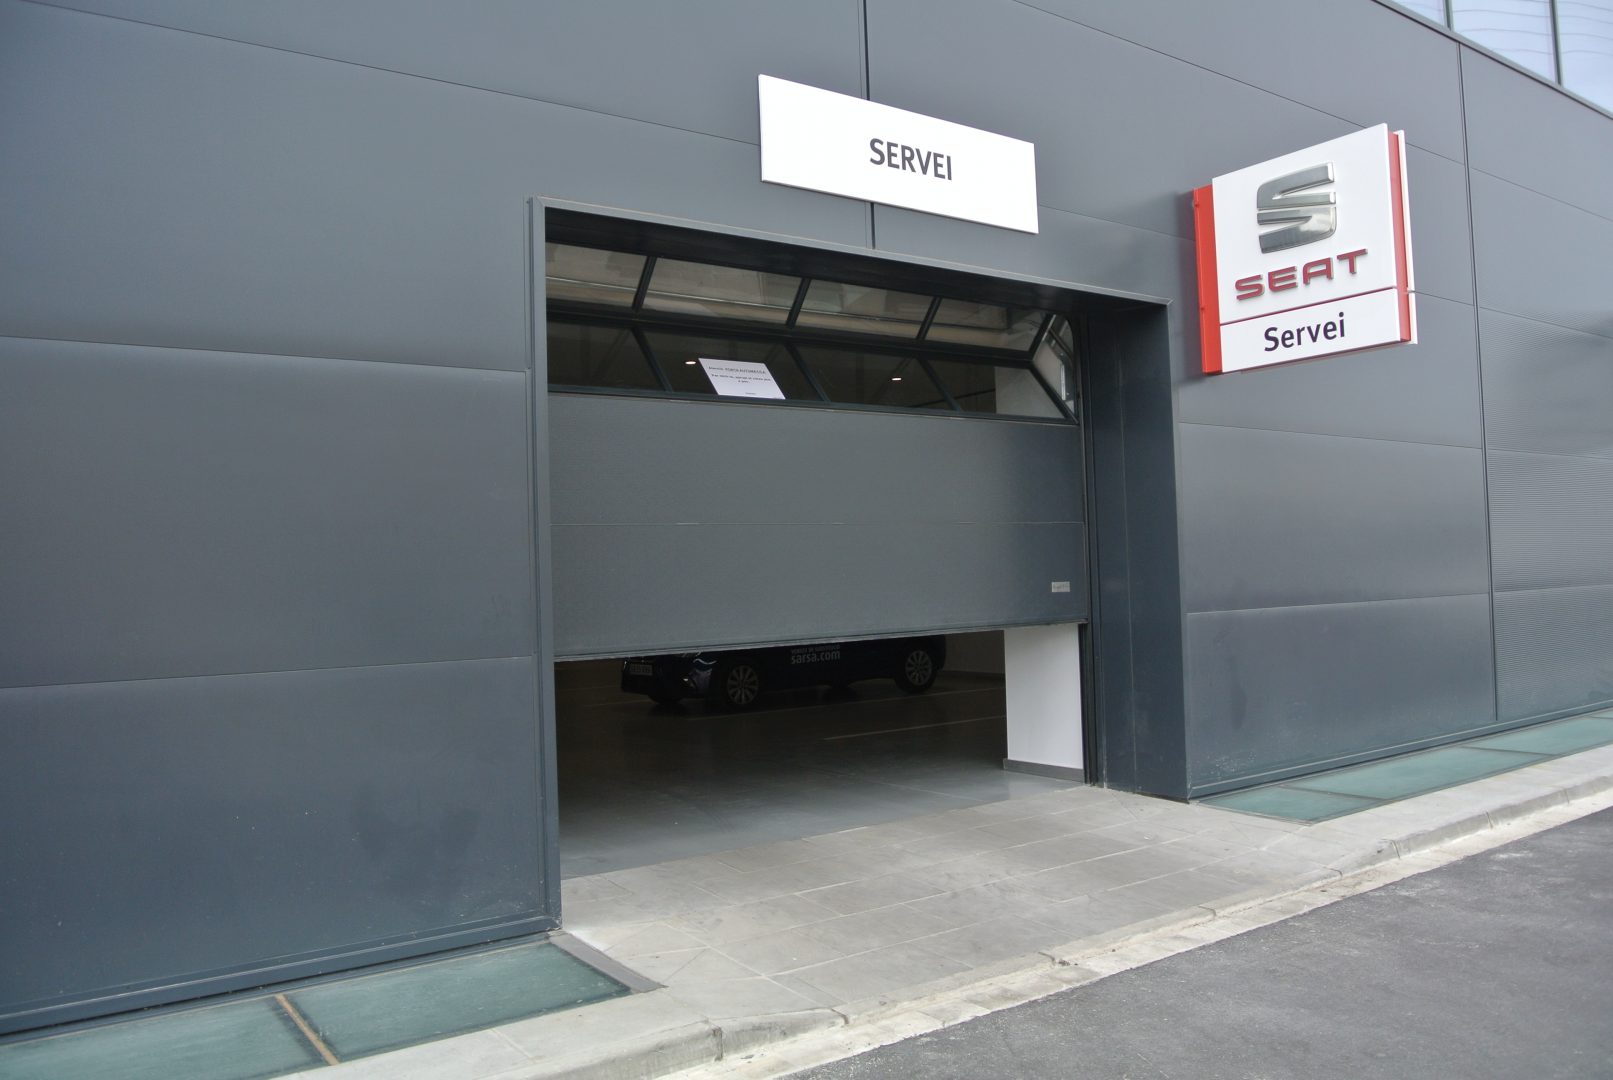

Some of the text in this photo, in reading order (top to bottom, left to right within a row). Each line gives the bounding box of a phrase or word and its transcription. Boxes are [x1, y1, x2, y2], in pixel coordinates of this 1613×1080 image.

[869, 138, 953, 181] SERVEI
[1234, 248, 1368, 301] SEAT
[1263, 312, 1346, 352] Servei
[791, 651, 841, 664] sarsa.com
